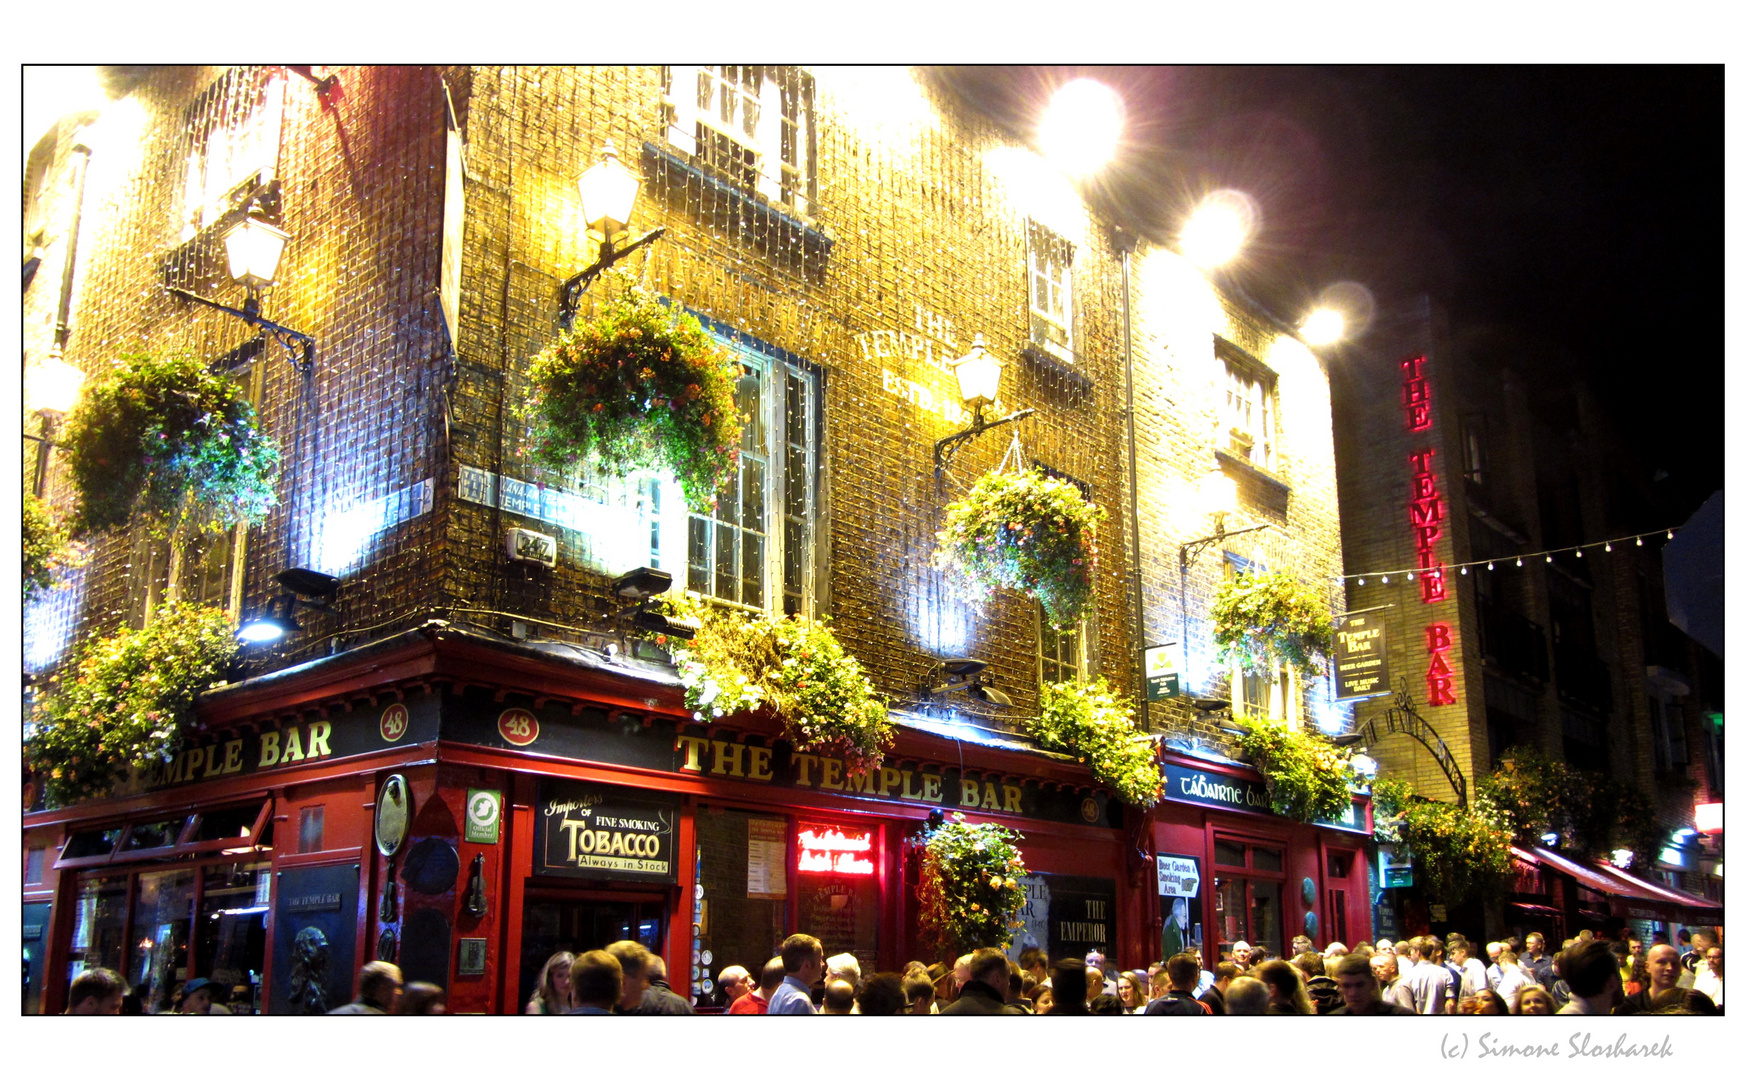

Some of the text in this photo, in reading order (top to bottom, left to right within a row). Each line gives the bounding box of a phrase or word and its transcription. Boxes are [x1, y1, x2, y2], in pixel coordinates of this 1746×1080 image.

[914, 304, 958, 348] THE
[853, 330, 955, 376] TEMPLE
[1400, 356, 1457, 707] THE TEMPLE BAR
[1350, 618, 1366, 627] THE
[1337, 629, 1380, 643] TEMPLE
[1347, 641, 1371, 653] BAR
[1340, 659, 1381, 671] BEER GARDEN
[1353, 684, 1371, 692] DAILY
[1360, 677, 1379, 685] MUSIC
[384, 711, 402, 735] 48
[505, 712, 531, 738] 48
[258, 720, 332, 768] BAR
[677, 735, 1024, 813] THE TEMPLE BAR
[544, 794, 603, 818] Importers
[581, 809, 592, 817] OF
[596, 816, 660, 832] FINE SMOKING
[559, 818, 660, 862] TOBACCO
[580, 856, 619, 868] Always
[637, 860, 667, 872] Stock
[1158, 858, 1171, 870] Beer
[1172, 861, 1191, 873] Garden
[1158, 871, 1181, 885] Smoking
[1163, 883, 1177, 894] Area
[1086, 900, 1106, 919] THE
[1060, 922, 1106, 943] EMPEROR
